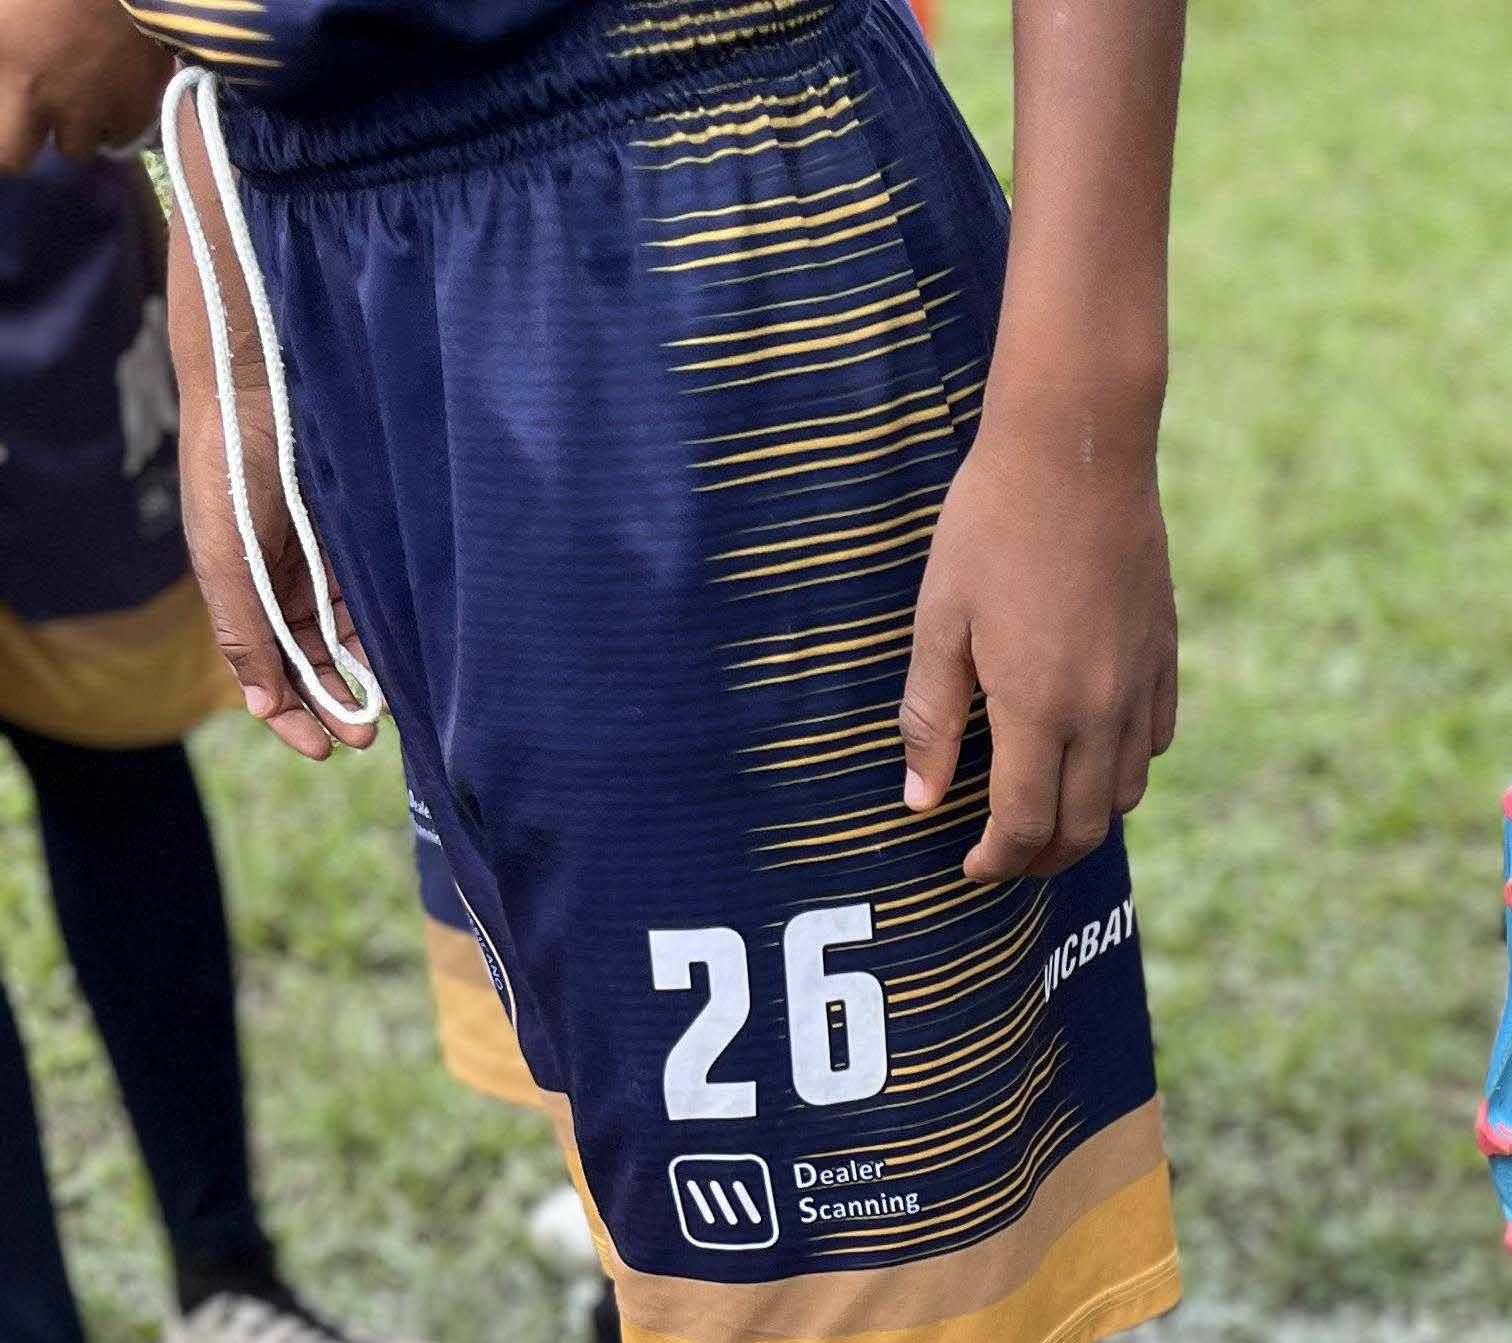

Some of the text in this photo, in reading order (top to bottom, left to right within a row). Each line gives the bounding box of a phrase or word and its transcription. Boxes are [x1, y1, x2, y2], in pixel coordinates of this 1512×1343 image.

[647, 902, 889, 1122] 26
[793, 1160, 885, 1189] Dealer
[799, 1192, 921, 1223] Scanning
